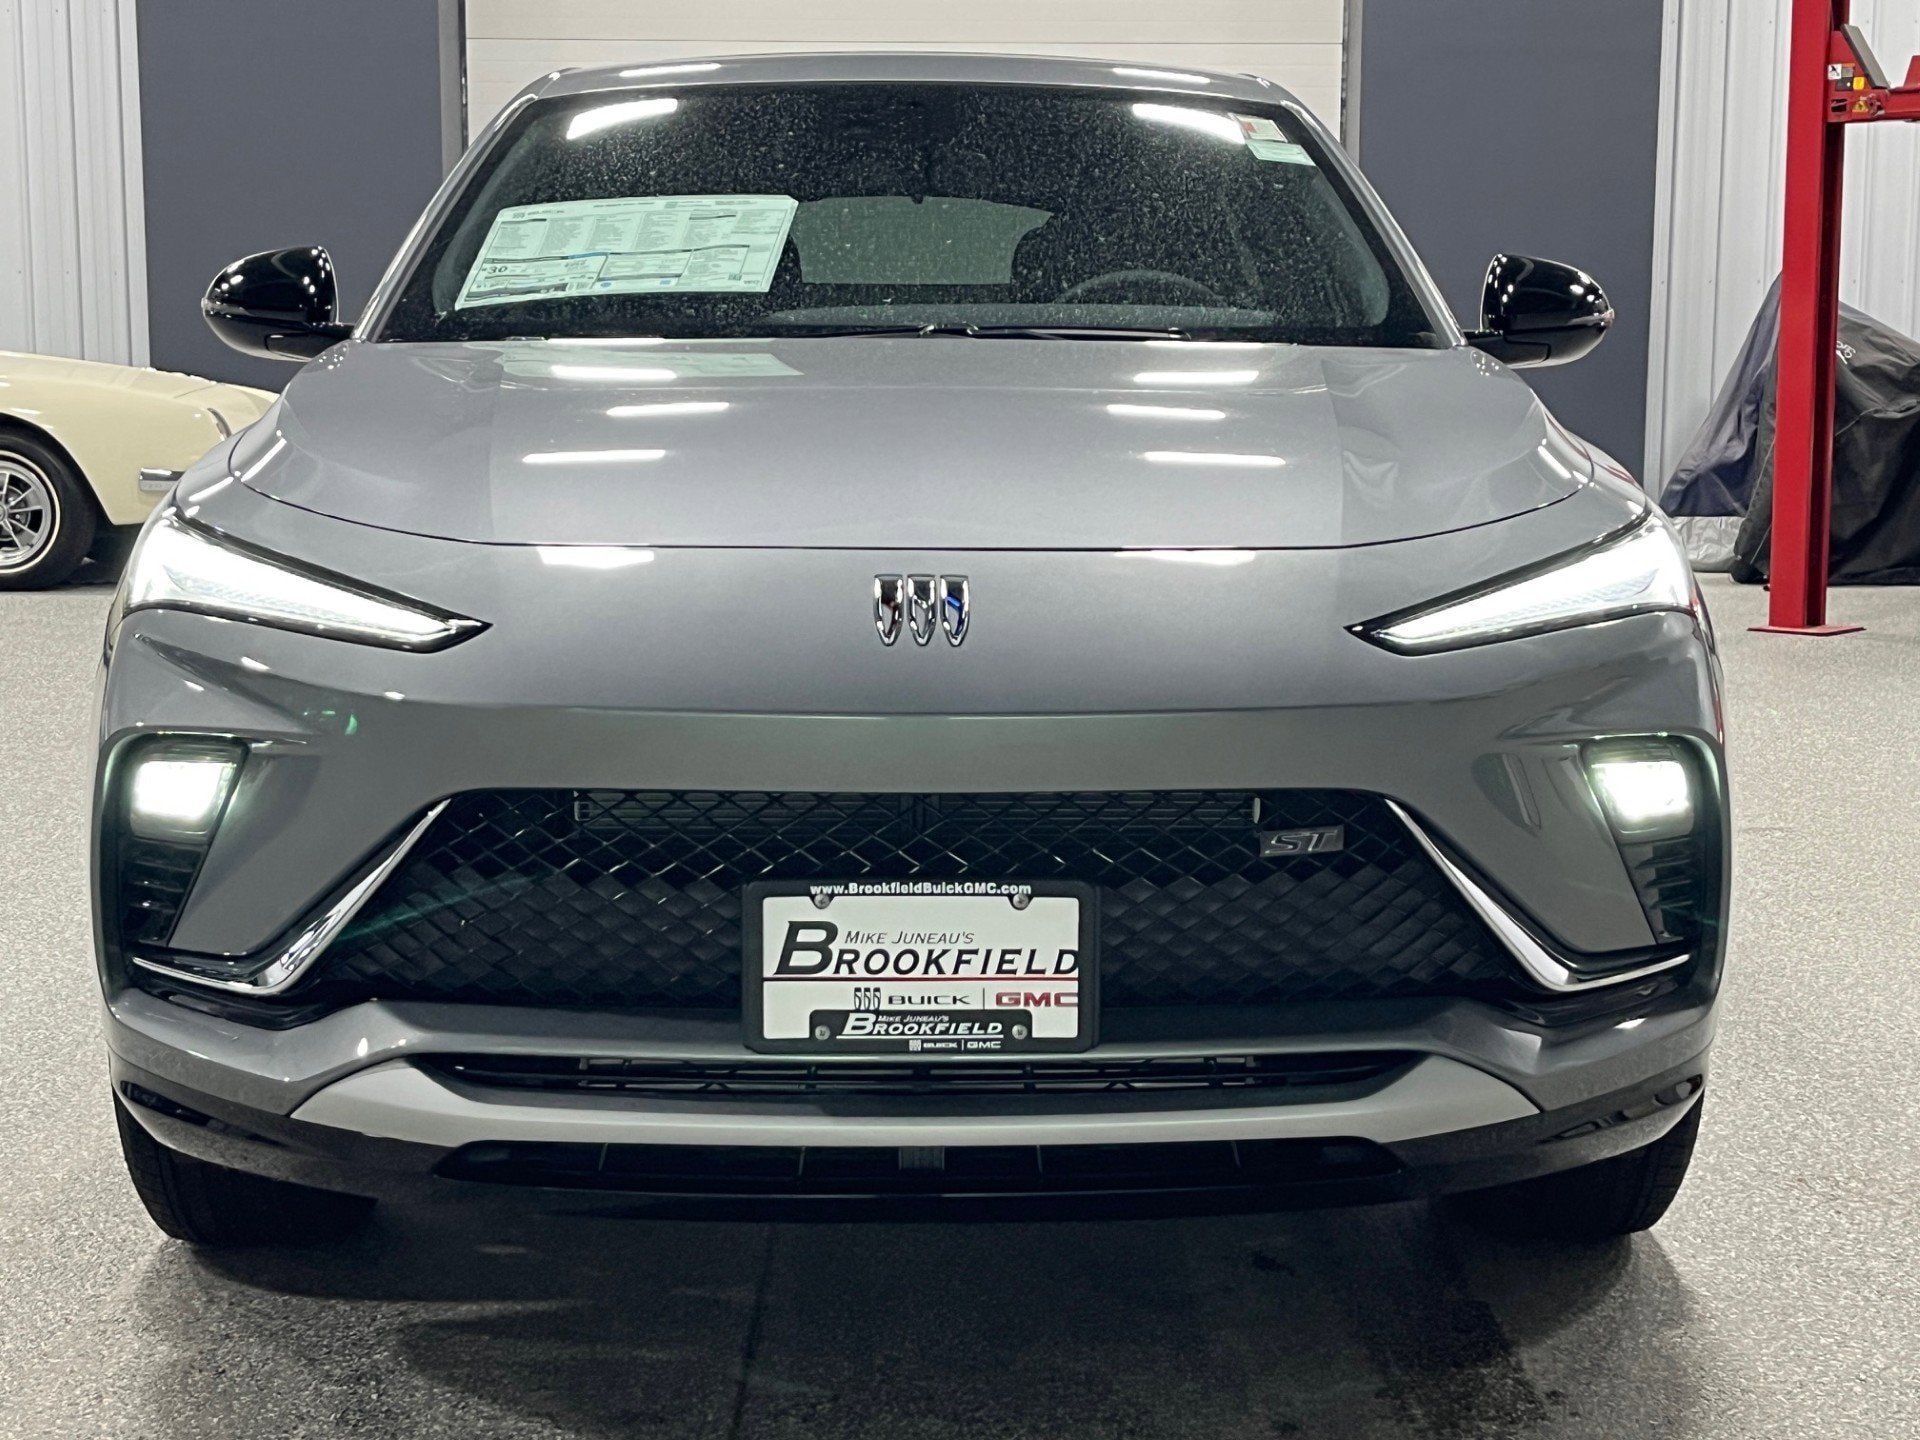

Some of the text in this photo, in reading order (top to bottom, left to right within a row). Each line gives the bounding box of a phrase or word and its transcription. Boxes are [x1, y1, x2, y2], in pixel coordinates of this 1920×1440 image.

[1265, 830, 1338, 854] ST
[810, 882, 1032, 895] www.BrookfieldBuickGMC.com
[845, 931, 975, 944] MIKE JUNEAU'S
[773, 920, 1079, 975] BROOKFIELD
[888, 992, 1079, 1007] BUICK GMC
[842, 1012, 1003, 1036] BROOKFIELD
[877, 1014, 950, 1023] MIKE JUNEAU'S
[966, 1041, 1001, 1049] GMC
